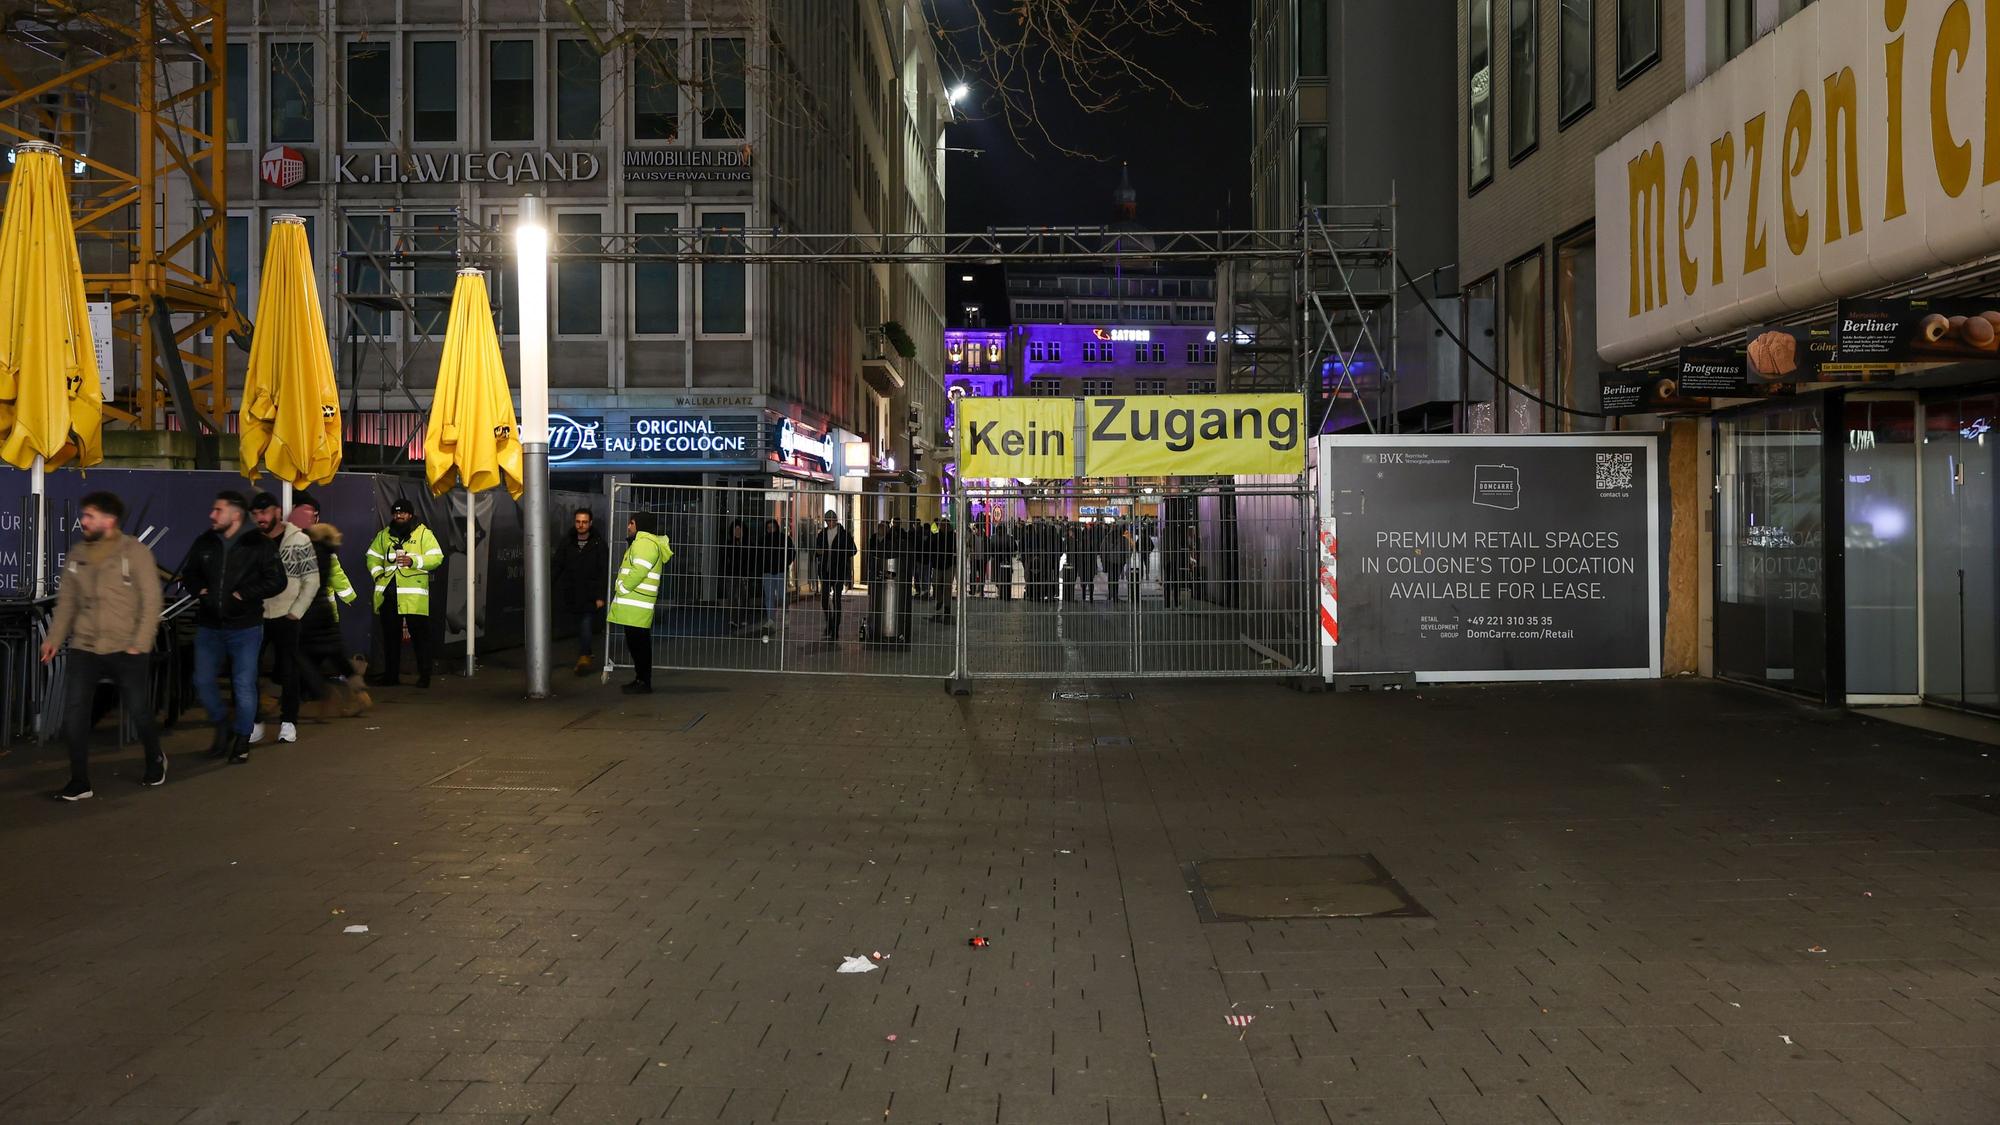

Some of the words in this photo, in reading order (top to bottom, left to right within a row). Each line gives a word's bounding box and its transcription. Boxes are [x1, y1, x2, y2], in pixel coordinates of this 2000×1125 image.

[622, 150, 712, 167] IMMOBILIEN
[622, 171, 751, 181] HAUSVERWALTUNG
[1842, 319, 1899, 332] Berliner
[1110, 329, 1150, 342] SATURN
[1682, 363, 1740, 376] Brotgenuss
[1603, 385, 1642, 395] Berliner
[676, 396, 753, 406] WALLRAFPLATZ
[636, 419, 715, 435] ORIGINAL
[969, 420, 1065, 456] Kein
[1092, 398, 1298, 452] Zugang
[605, 436, 636, 451] EAU
[640, 436, 661, 451] DE
[663, 436, 746, 451] COLOGNE
[1379, 452, 1404, 464] BVK
[1600, 491, 1620, 499] contact
[1621, 491, 1629, 499] us
[1376, 531, 1467, 549] PREMIUM
[1474, 531, 1540, 549] RETAIL
[1545, 531, 1620, 549] SPACES
[1361, 556, 1379, 574] IN
[1386, 556, 1493, 574] COLOGNE'S
[1498, 556, 1536, 574] TOP
[1542, 556, 1635, 574] LOCATION
[1389, 582, 1491, 600] AVAILABLE
[1497, 582, 1535, 600] FOR
[1541, 582, 1606, 600] LEASE.
[1420, 615, 1439, 623] RETAIL
[1466, 616, 1485, 626] +49
[1486, 616, 1504, 626] 221
[1506, 616, 1525, 626] 310
[1526, 616, 1539, 626] 35
[1540, 616, 1553, 626] 35
[1420, 623, 1459, 631] DEVELOPMENT
[1466, 628, 1574, 640] DomCarre.com/Retail
